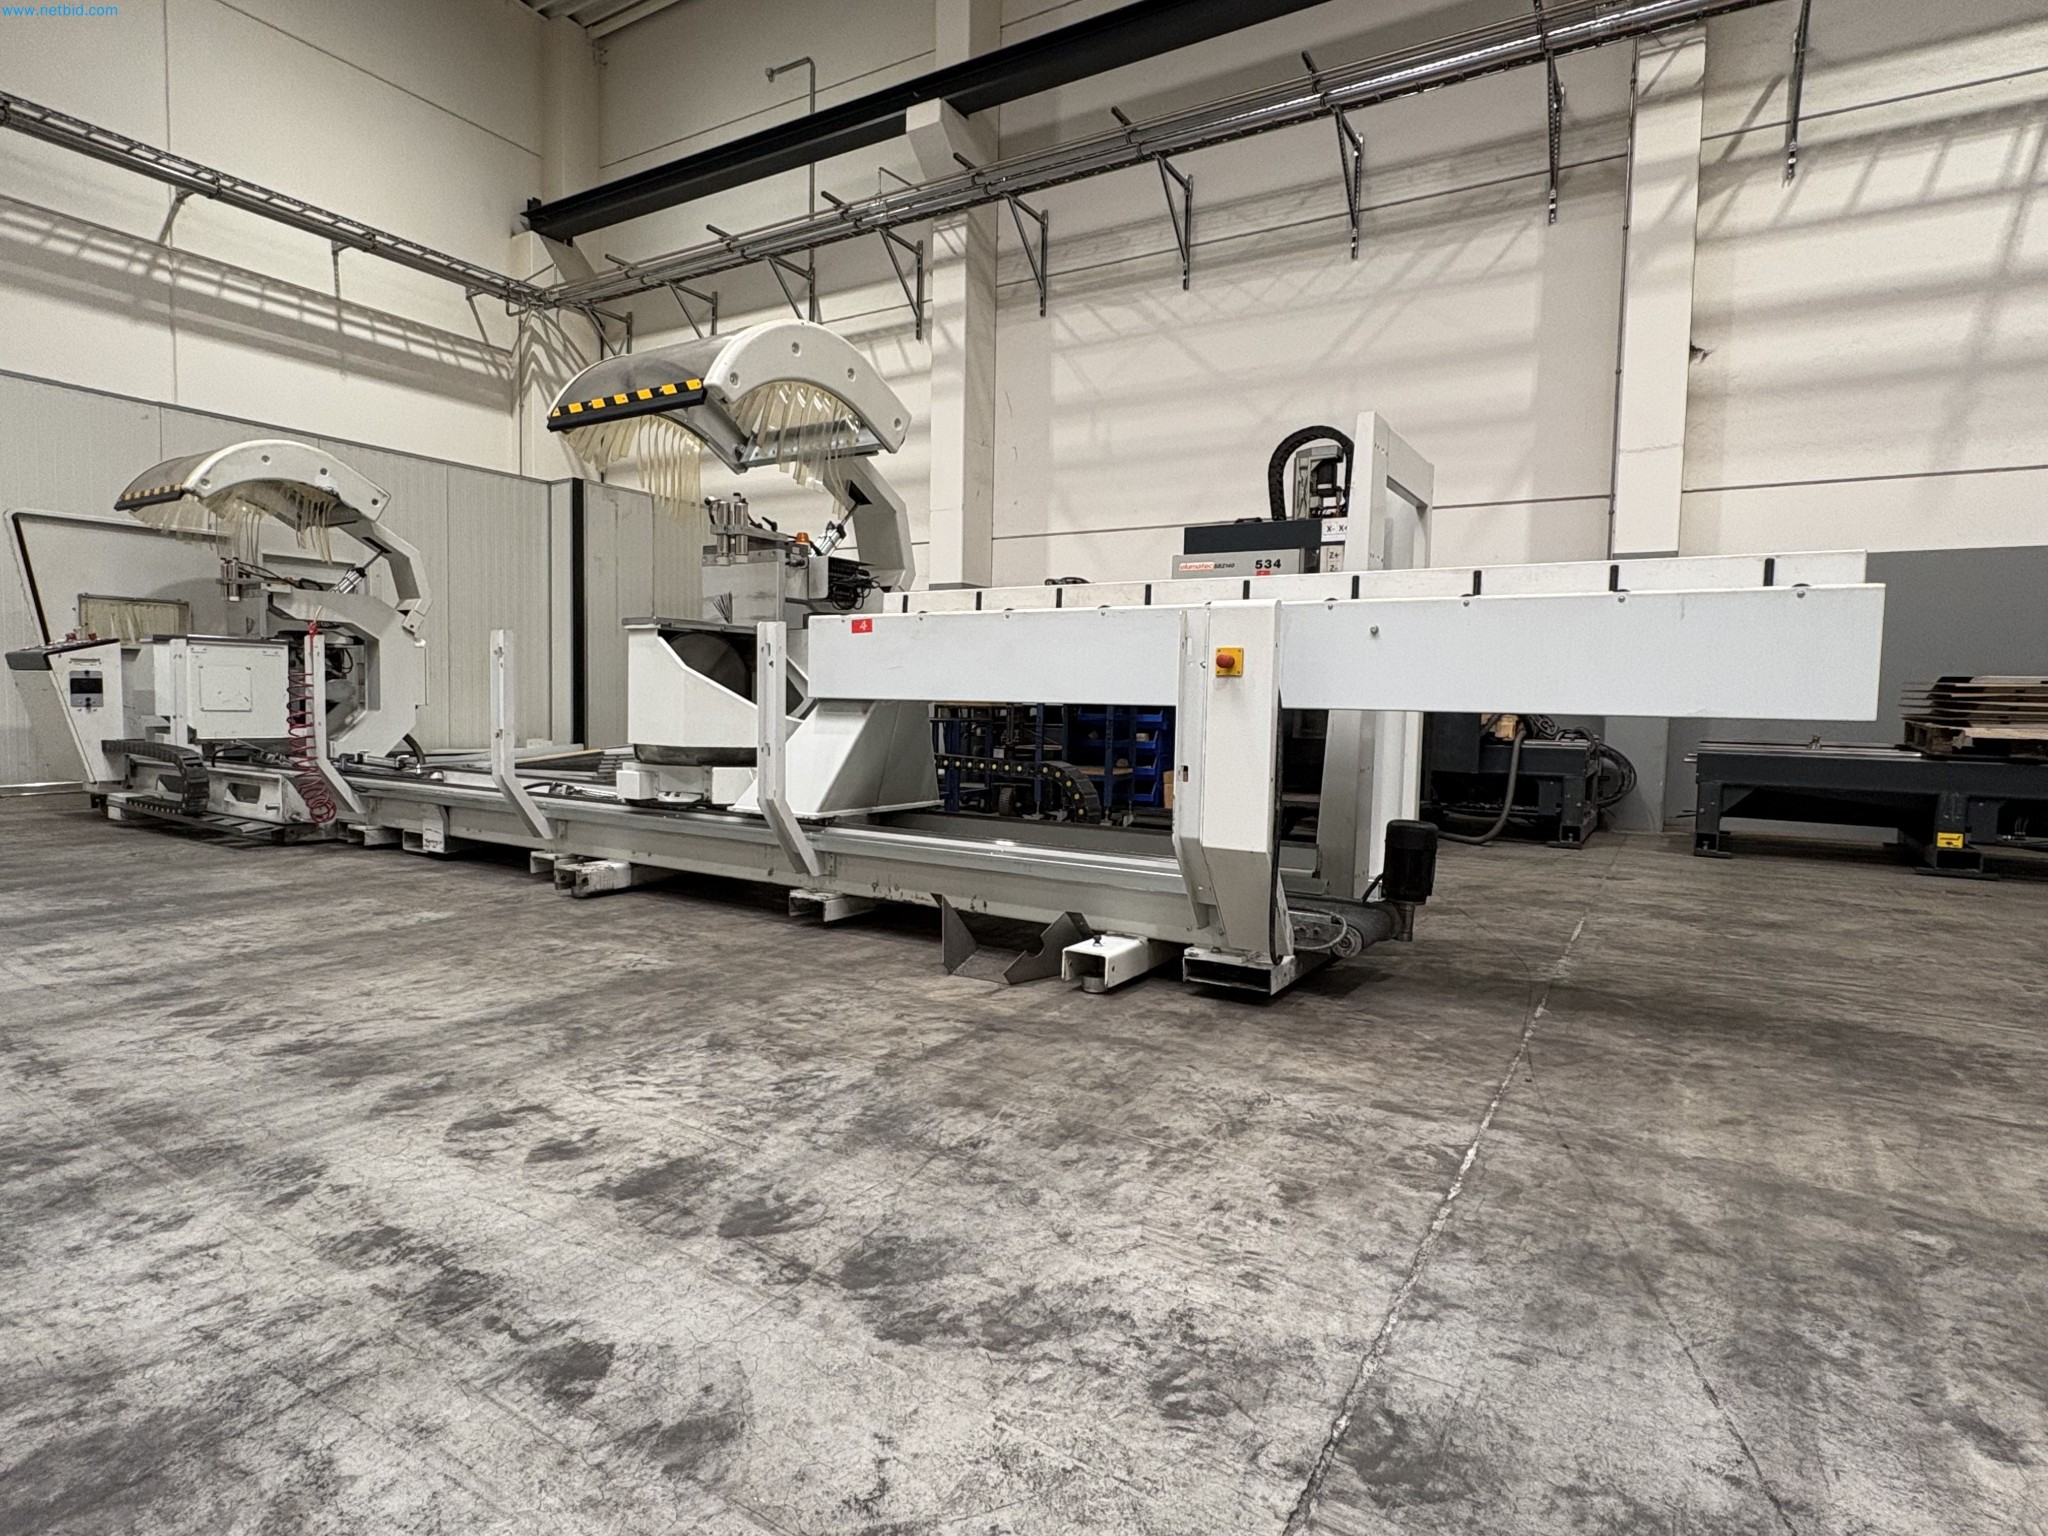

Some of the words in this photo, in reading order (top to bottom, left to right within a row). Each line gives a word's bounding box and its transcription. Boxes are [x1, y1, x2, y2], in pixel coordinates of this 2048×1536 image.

[1329, 551, 1339, 559] Z+
[1255, 559, 1281, 569] 534
[859, 620, 868, 631] 4
